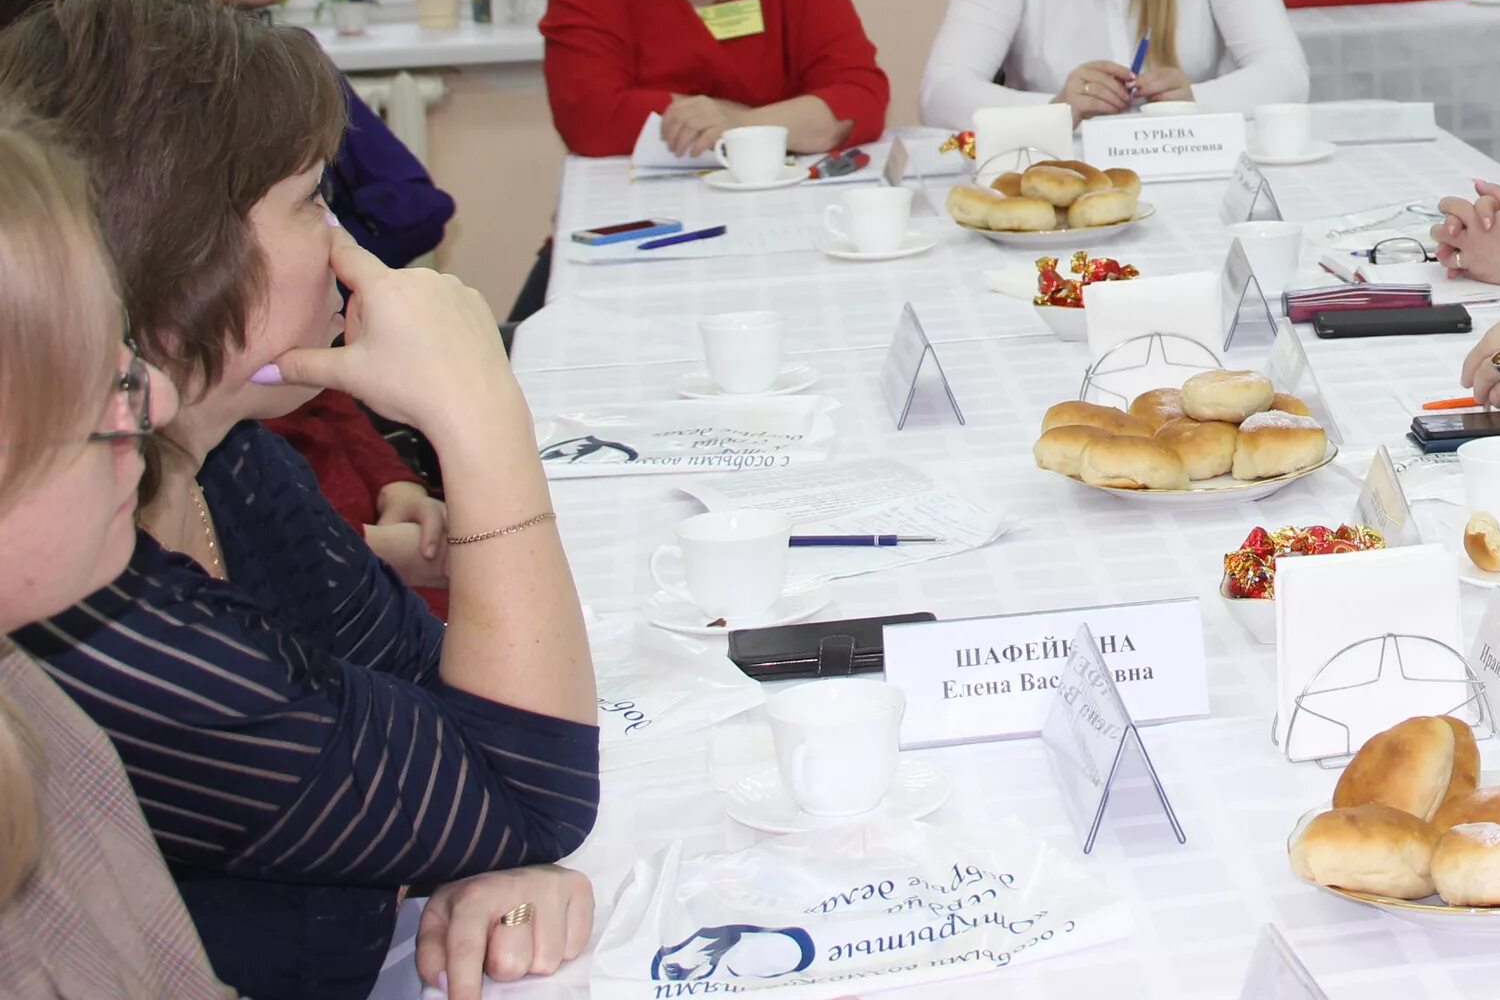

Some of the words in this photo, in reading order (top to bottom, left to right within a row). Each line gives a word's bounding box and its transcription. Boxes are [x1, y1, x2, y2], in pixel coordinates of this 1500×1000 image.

[1134, 128, 1195, 140] ГУРЬЕВА
[1108, 146, 1159, 157] Наталья
[1162, 143, 1223, 155] Сергеевна
[955, 633, 1137, 668] ШАФЕЙКНА
[942, 680, 1012, 700] Елена
[1020, 665, 1154, 692] Васвна
